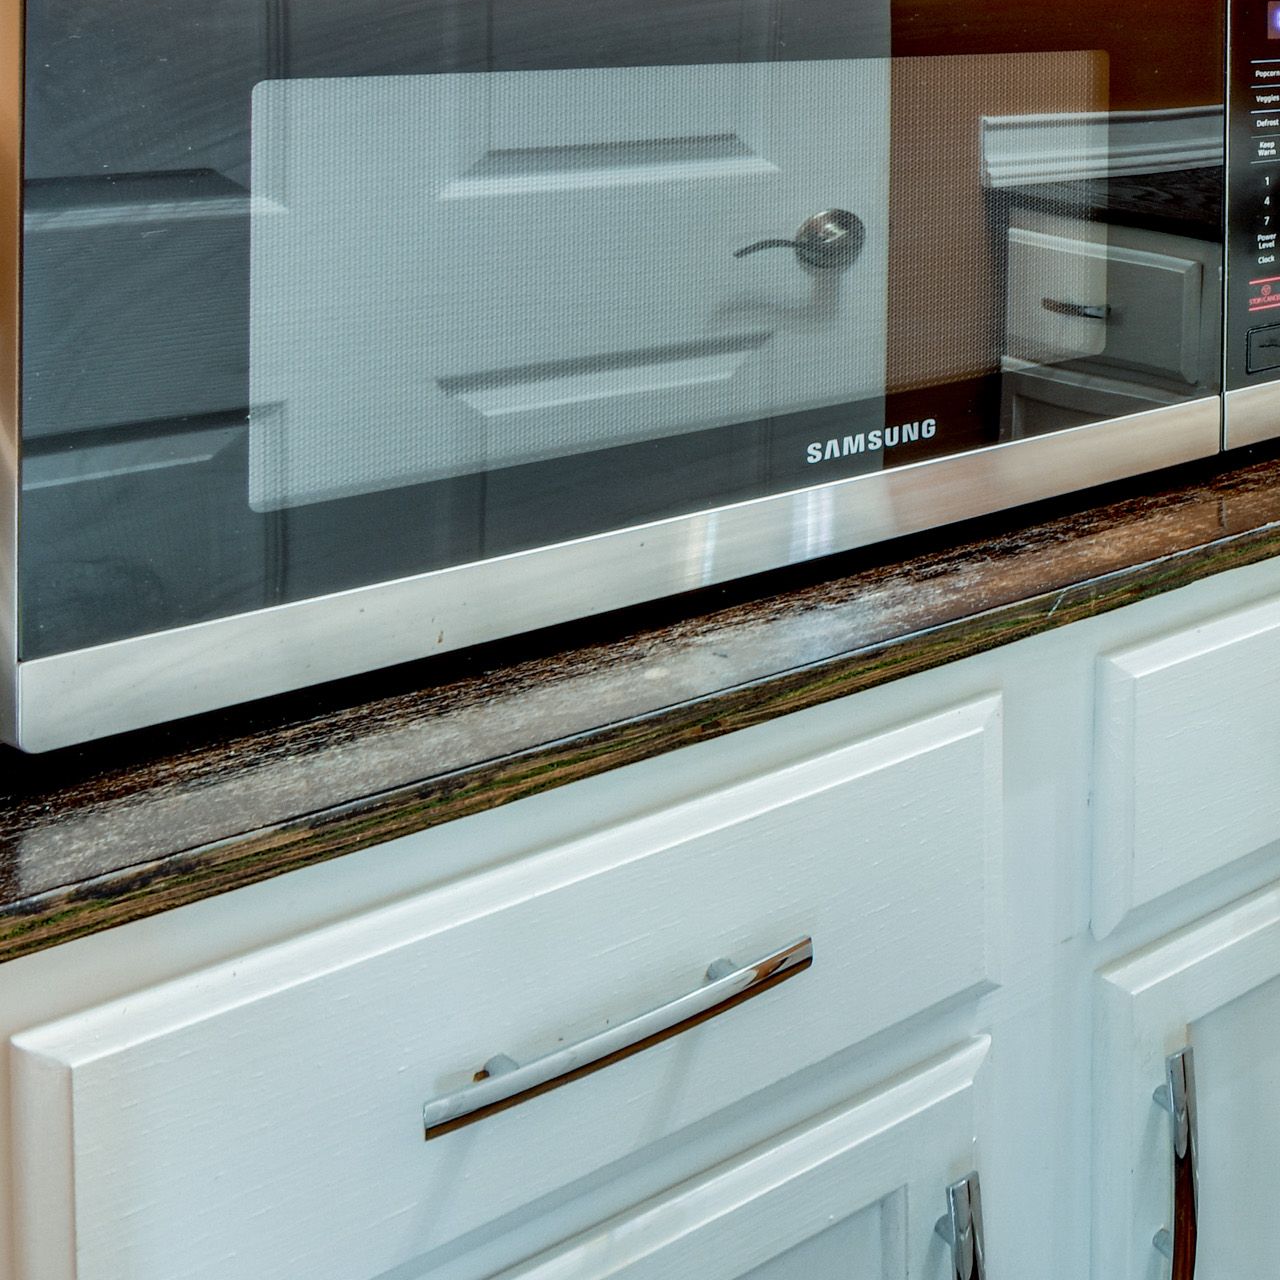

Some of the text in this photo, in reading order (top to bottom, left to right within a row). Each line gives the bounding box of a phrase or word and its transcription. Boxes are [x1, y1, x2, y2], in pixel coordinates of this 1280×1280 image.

[1255, 69, 1280, 78] Popcorn
[1256, 94, 1280, 103] Veggies
[1256, 118, 1280, 127] Defrost
[1259, 141, 1275, 149] Keep
[1258, 149, 1277, 157] Warm
[1264, 176, 1270, 186] 1
[1263, 196, 1270, 206] 4
[1263, 215, 1270, 226] 7
[1257, 233, 1277, 242] Power
[1258, 240, 1275, 250] Level
[1258, 255, 1275, 264] Clock
[806, 418, 937, 464] SAMSUNG
